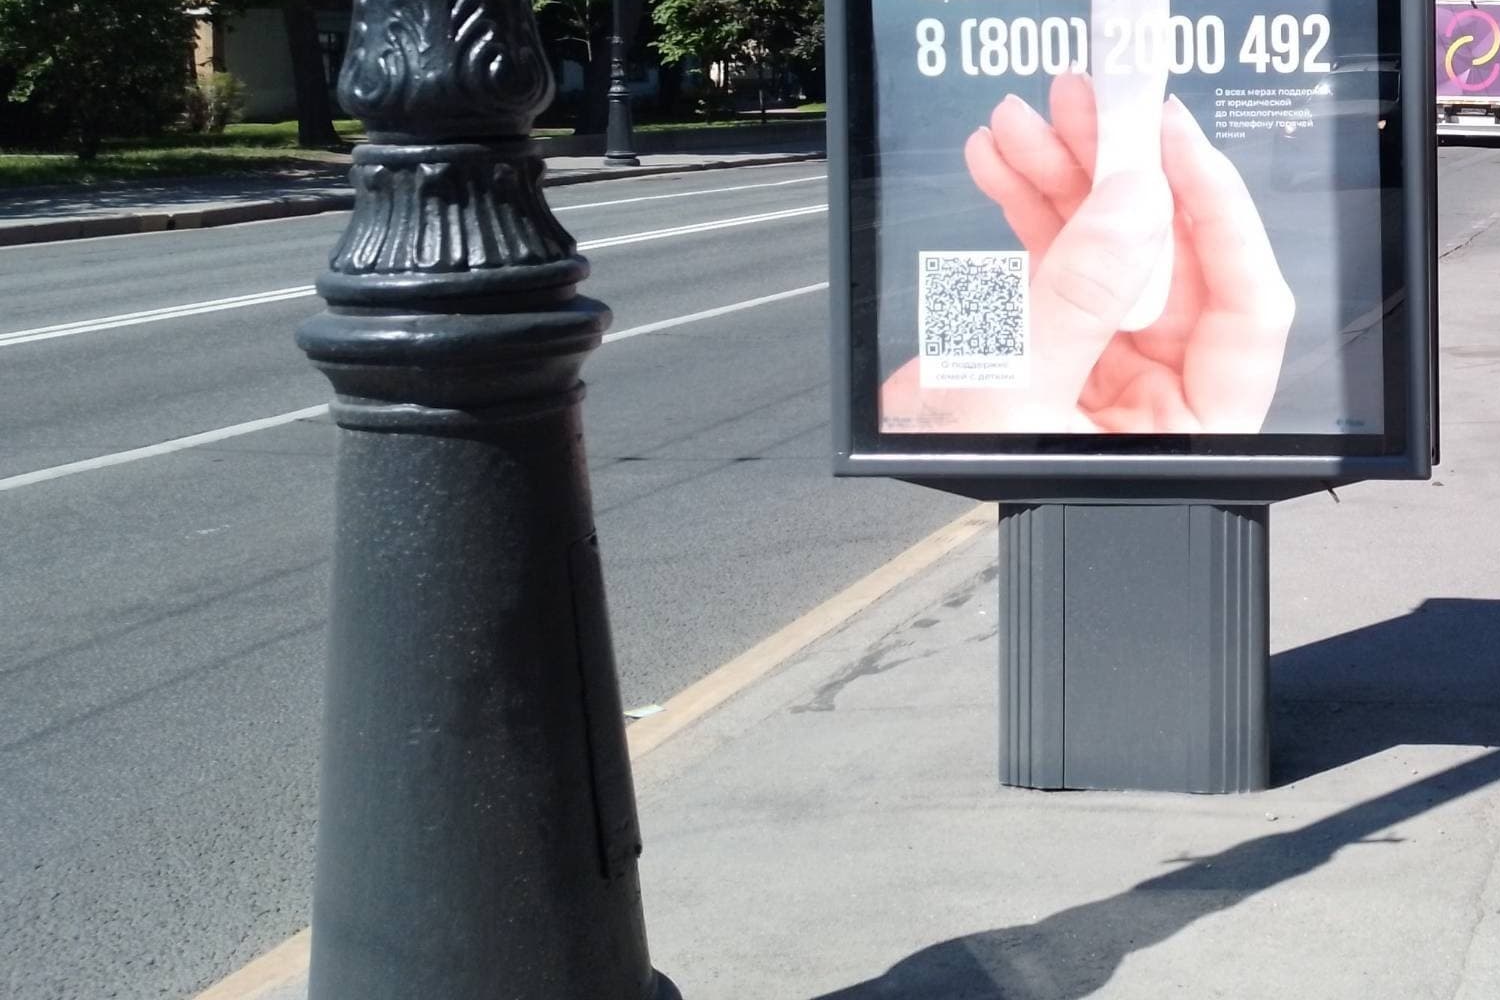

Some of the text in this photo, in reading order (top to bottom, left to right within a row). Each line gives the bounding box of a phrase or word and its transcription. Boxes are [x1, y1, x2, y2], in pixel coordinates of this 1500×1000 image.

[916, 13, 1332, 77] 8 (800) 2000 492
[1215, 88, 1223, 96] О
[1247, 89, 1276, 98] мерах
[1278, 88, 1334, 97] поддер,
[1227, 98, 1292, 108] юридической
[1215, 110, 1226, 118] до
[1229, 119, 1274, 129] телефону
